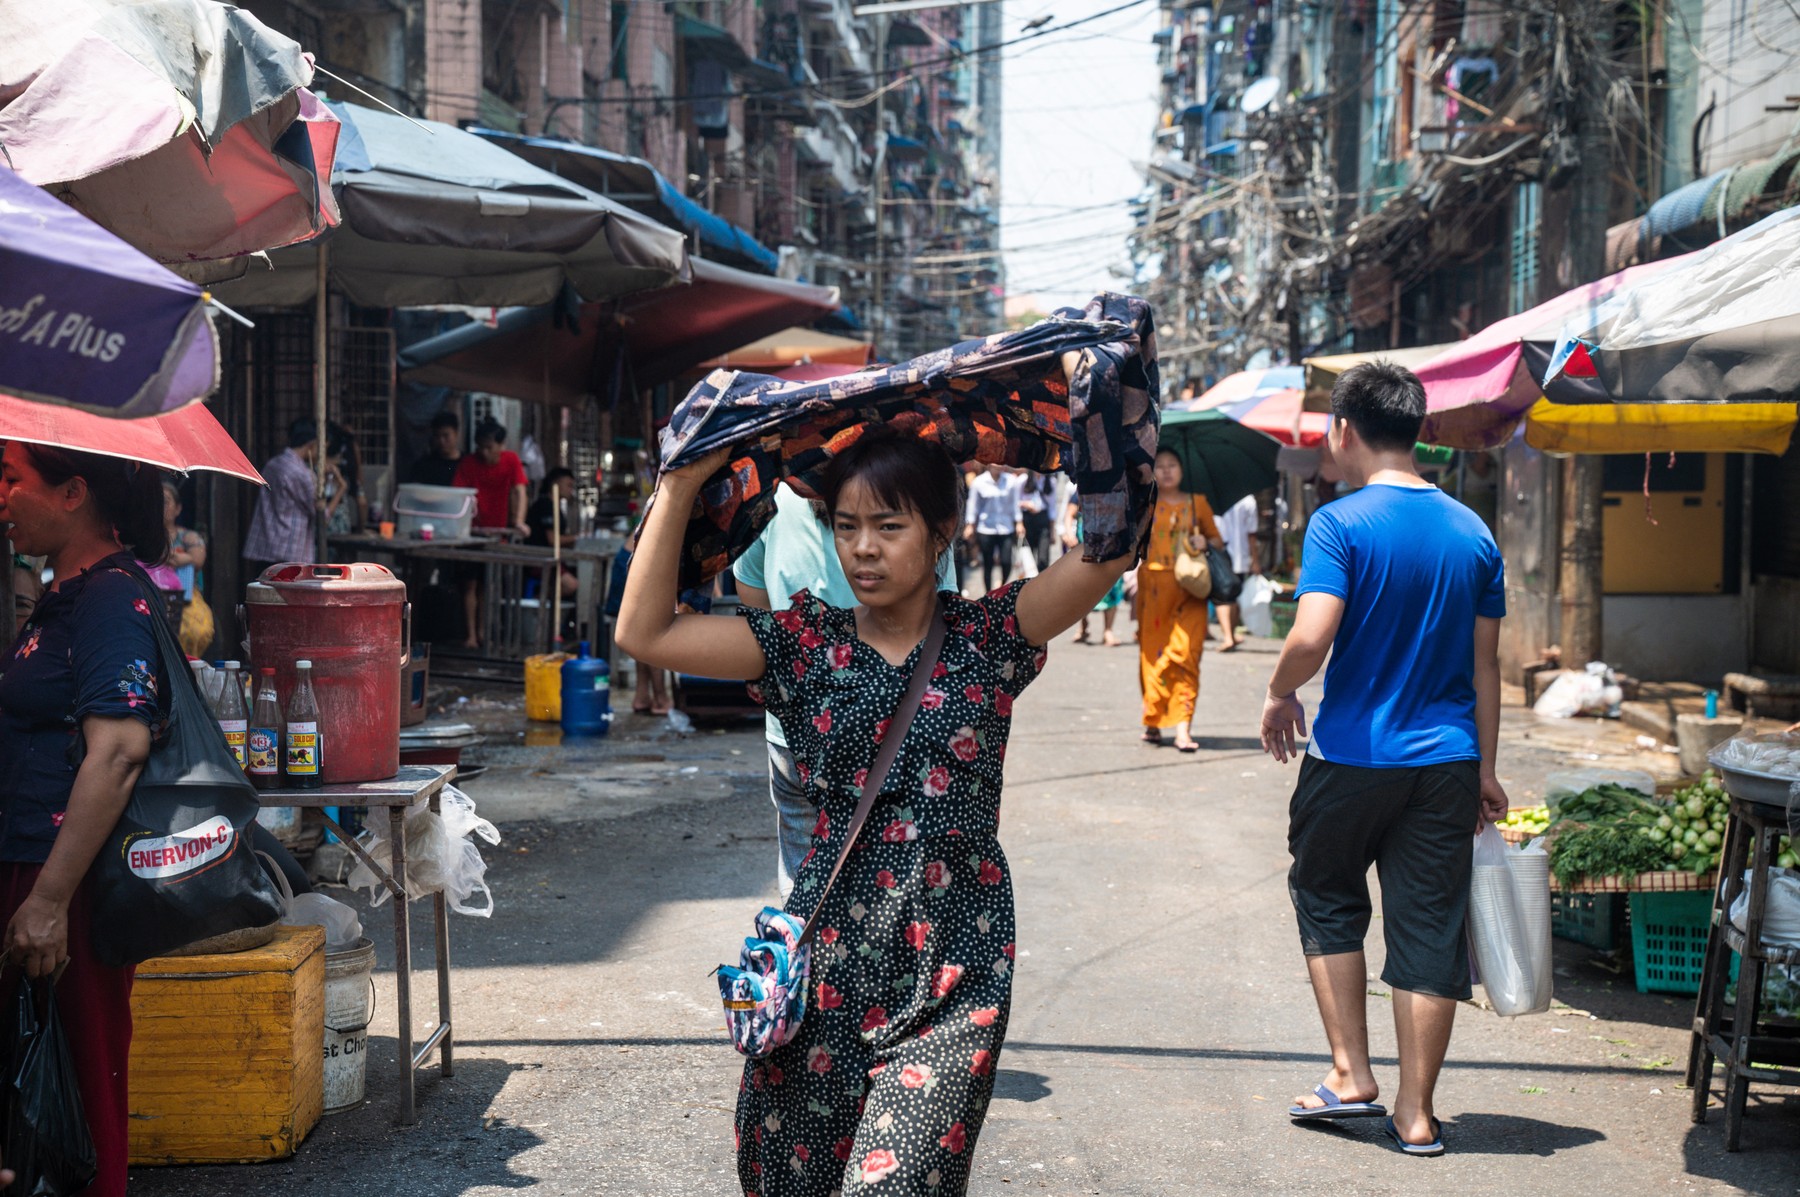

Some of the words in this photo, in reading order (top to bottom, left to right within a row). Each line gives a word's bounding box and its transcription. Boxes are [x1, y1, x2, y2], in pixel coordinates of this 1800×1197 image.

[20, 310, 57, 345] A
[48, 312, 126, 362] Plus
[130, 825, 228, 869] ENERVON-C
